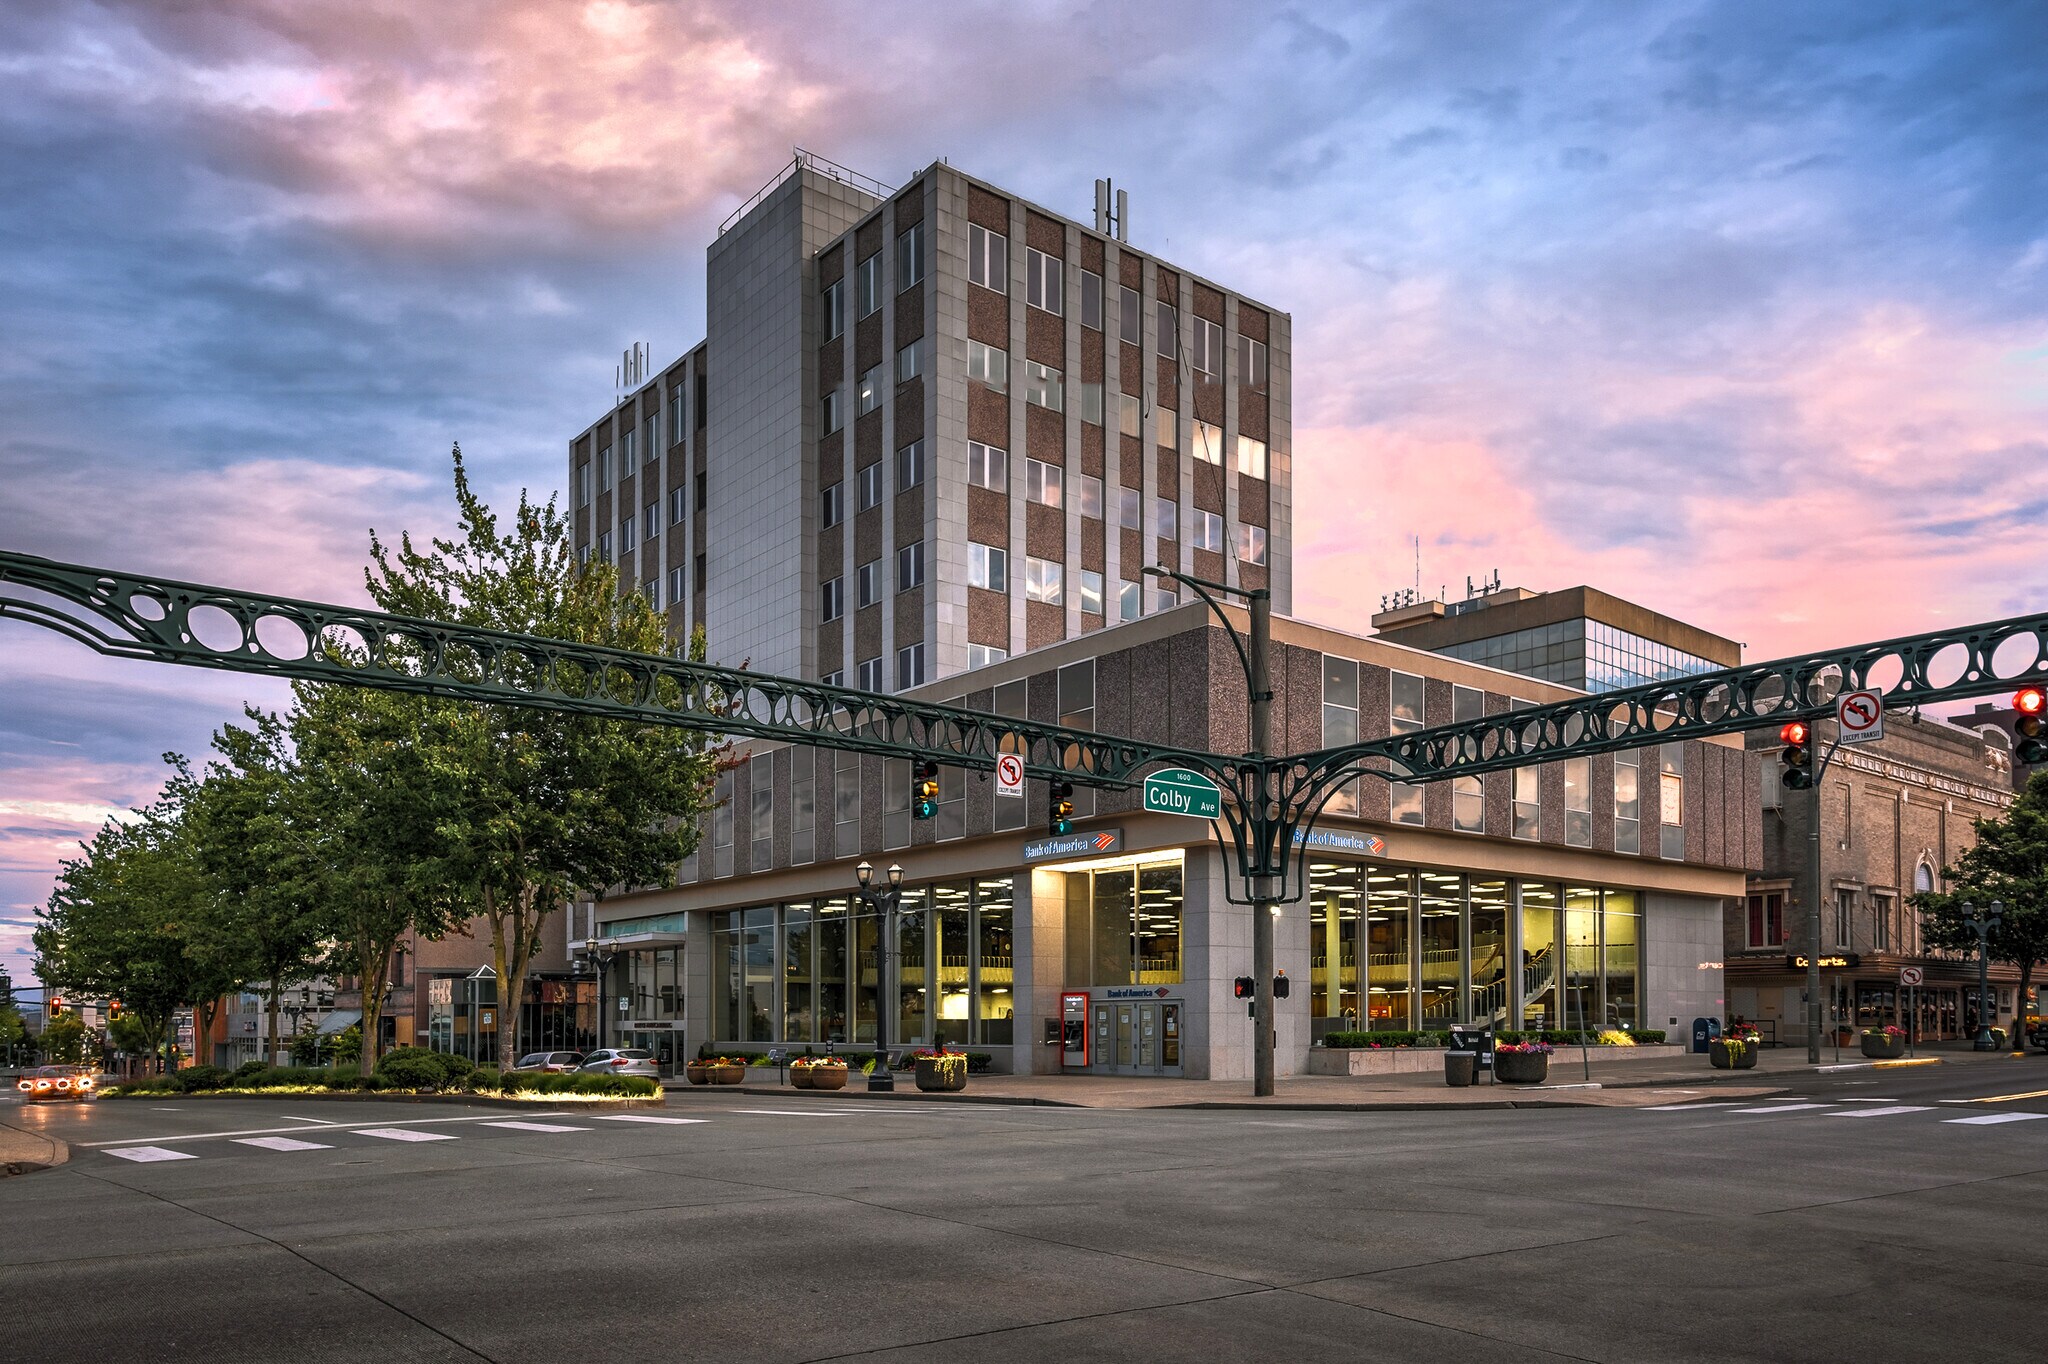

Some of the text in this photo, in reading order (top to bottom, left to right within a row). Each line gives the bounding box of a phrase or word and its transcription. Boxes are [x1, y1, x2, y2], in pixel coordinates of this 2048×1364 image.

[1843, 731, 1880, 741] EXCEPT TRANSIT
[1177, 773, 1191, 781] 1600
[1150, 787, 1215, 812] Colby Ave
[1319, 832, 1329, 845] of
[1329, 833, 1364, 849] America
[1026, 838, 1088, 857] Bank of America
[1108, 989, 1152, 997] Bank of America
